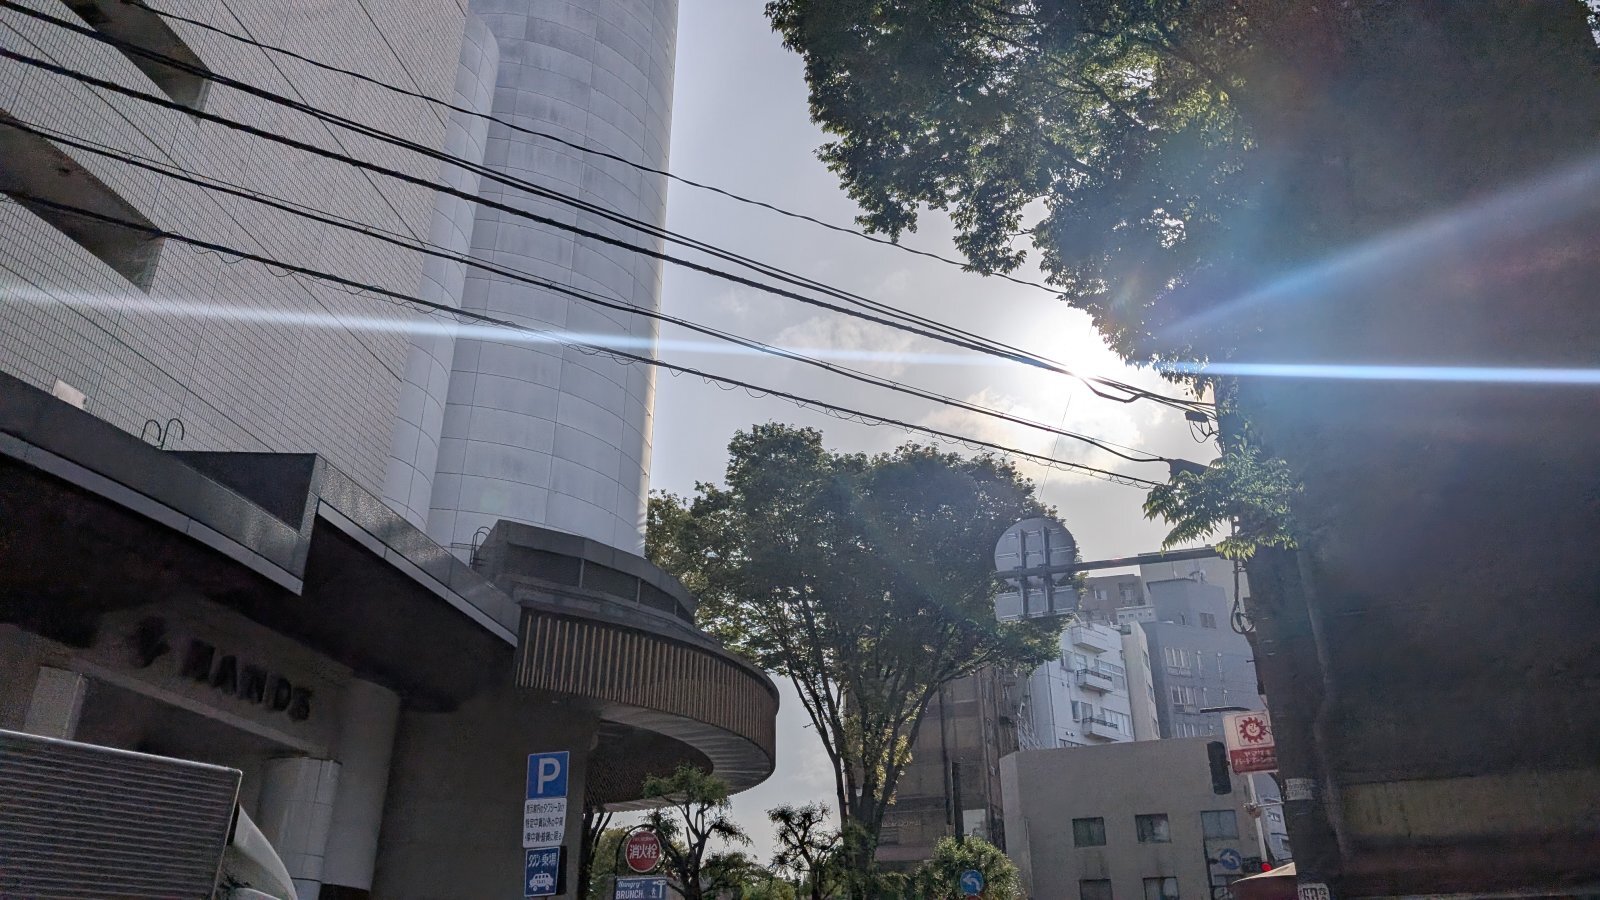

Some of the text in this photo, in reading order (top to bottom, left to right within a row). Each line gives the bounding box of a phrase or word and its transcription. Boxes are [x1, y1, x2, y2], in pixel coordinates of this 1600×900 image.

[182, 638, 312, 722] HANDS
[537, 757, 561, 794] P
[629, 843, 658, 860] 消火栓
